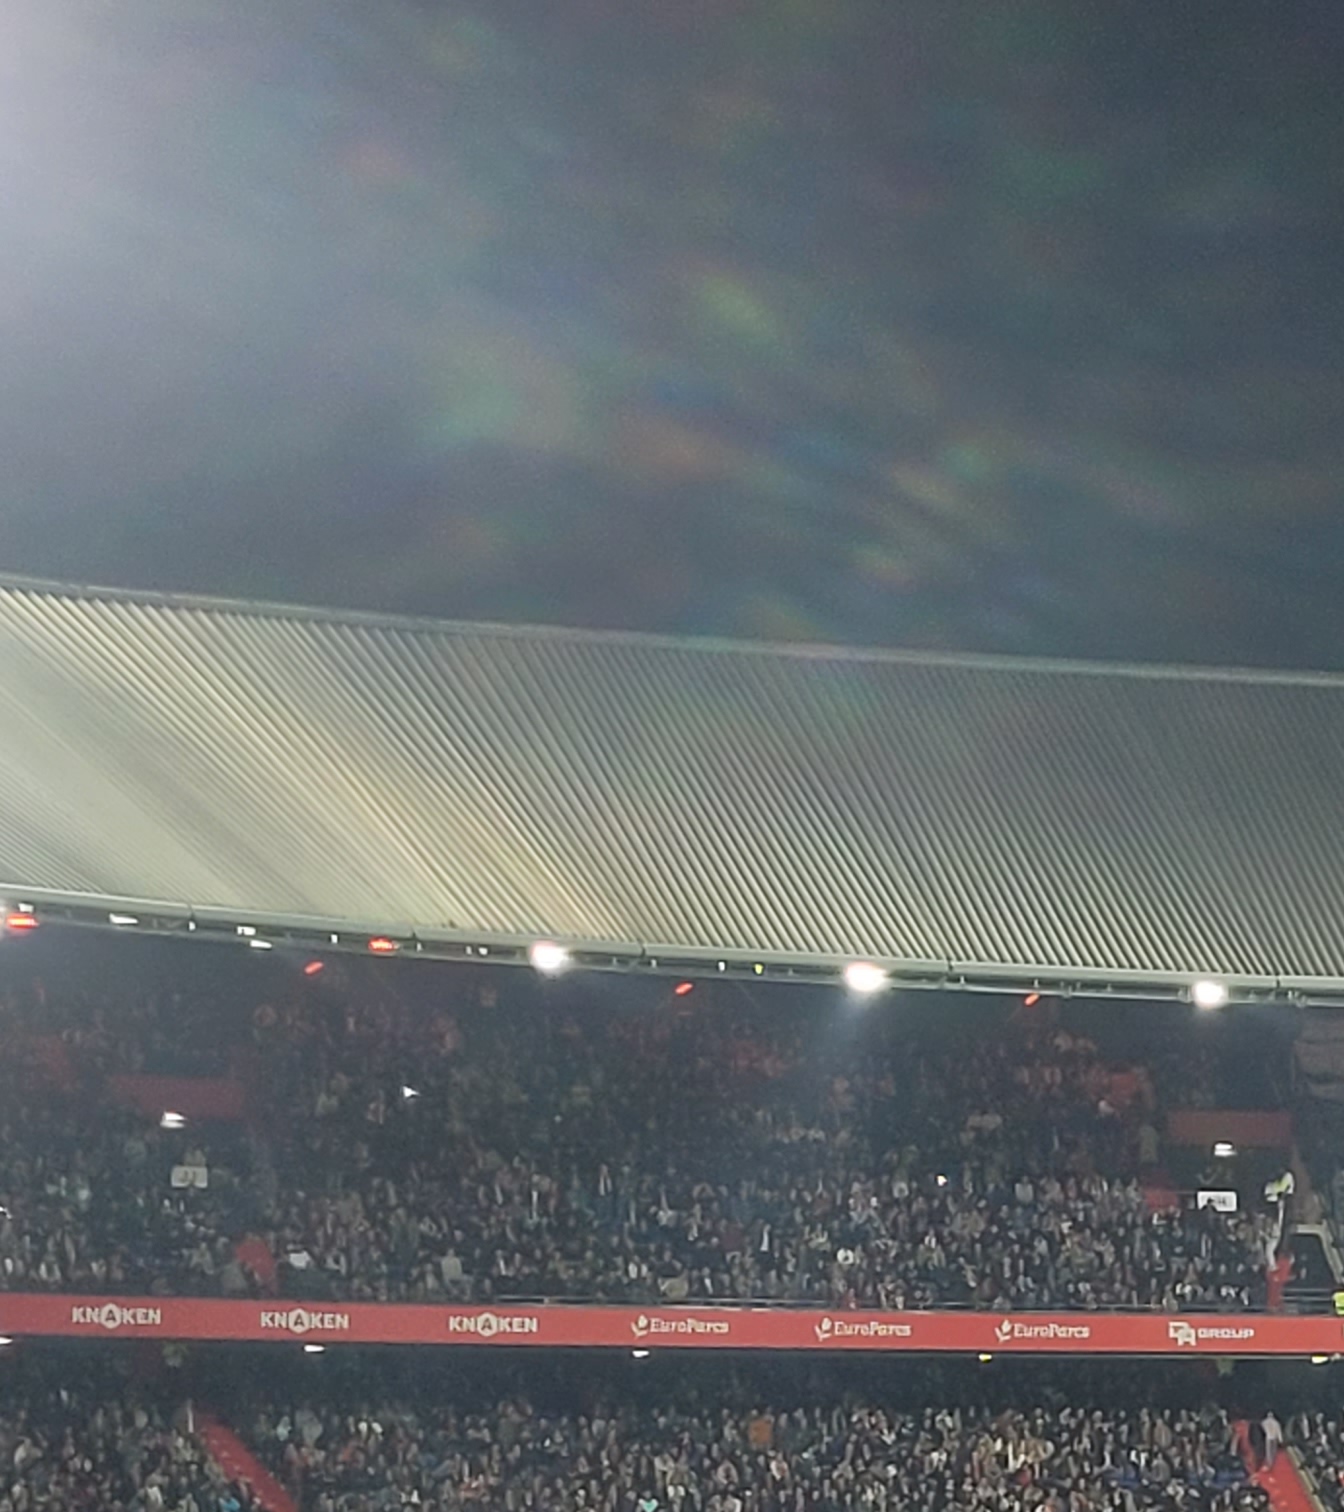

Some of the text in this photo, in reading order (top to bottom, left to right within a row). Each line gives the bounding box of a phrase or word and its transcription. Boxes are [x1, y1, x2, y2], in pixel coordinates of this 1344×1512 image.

[71, 1306, 161, 1330] KNAKEN
[259, 1309, 349, 1334] KNAKEN
[448, 1312, 538, 1337] KNAKEN
[1198, 1327, 1254, 1340] GROUP
